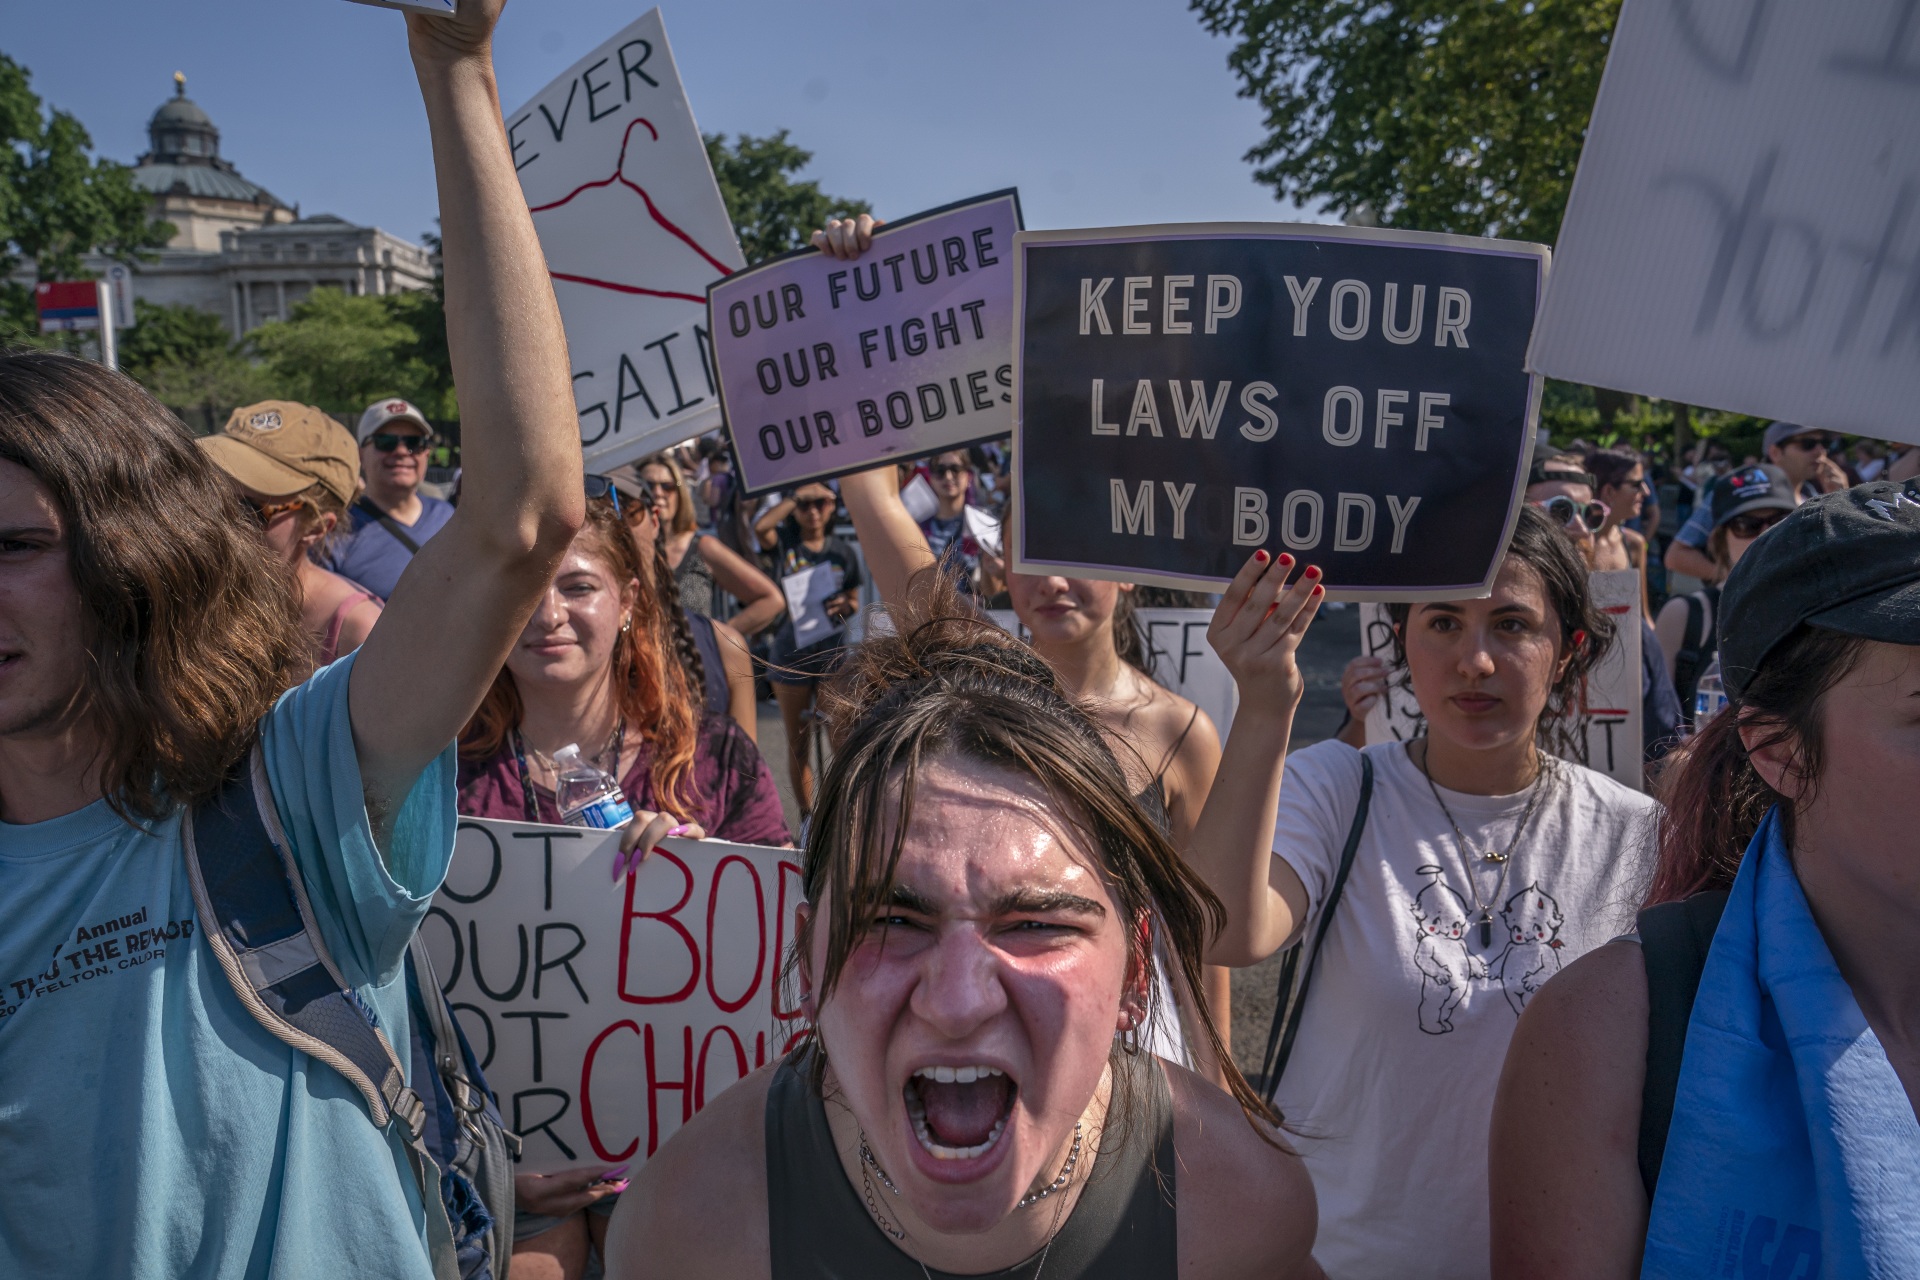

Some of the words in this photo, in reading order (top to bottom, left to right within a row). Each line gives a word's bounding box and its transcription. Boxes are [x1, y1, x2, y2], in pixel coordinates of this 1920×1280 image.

[509, 38, 660, 172] EVER
[729, 283, 806, 338] OUR
[828, 226, 999, 309] FUTURE
[1079, 274, 1242, 336] KEEP
[1283, 275, 1472, 349] YOUR
[572, 324, 717, 447] GAI
[756, 342, 839, 395] OUR
[859, 299, 986, 369] FIGHT
[759, 410, 840, 460] OUR
[857, 364, 1012, 437] BODIES
[1091, 378, 1279, 443] LAWS
[1322, 385, 1451, 452] OFF
[1110, 478, 1196, 540] MY
[1232, 486, 1422, 554] BODY
[1149, 620, 1210, 684] FF
[64, 938, 121, 970] THE
[76, 906, 147, 944] Annual
[421, 906, 589, 1004] OUR
[440, 821, 583, 912] OT
[617, 845, 804, 1021] BOD
[35, 965, 114, 998] FELTON,
[450, 1002, 570, 1083] OT
